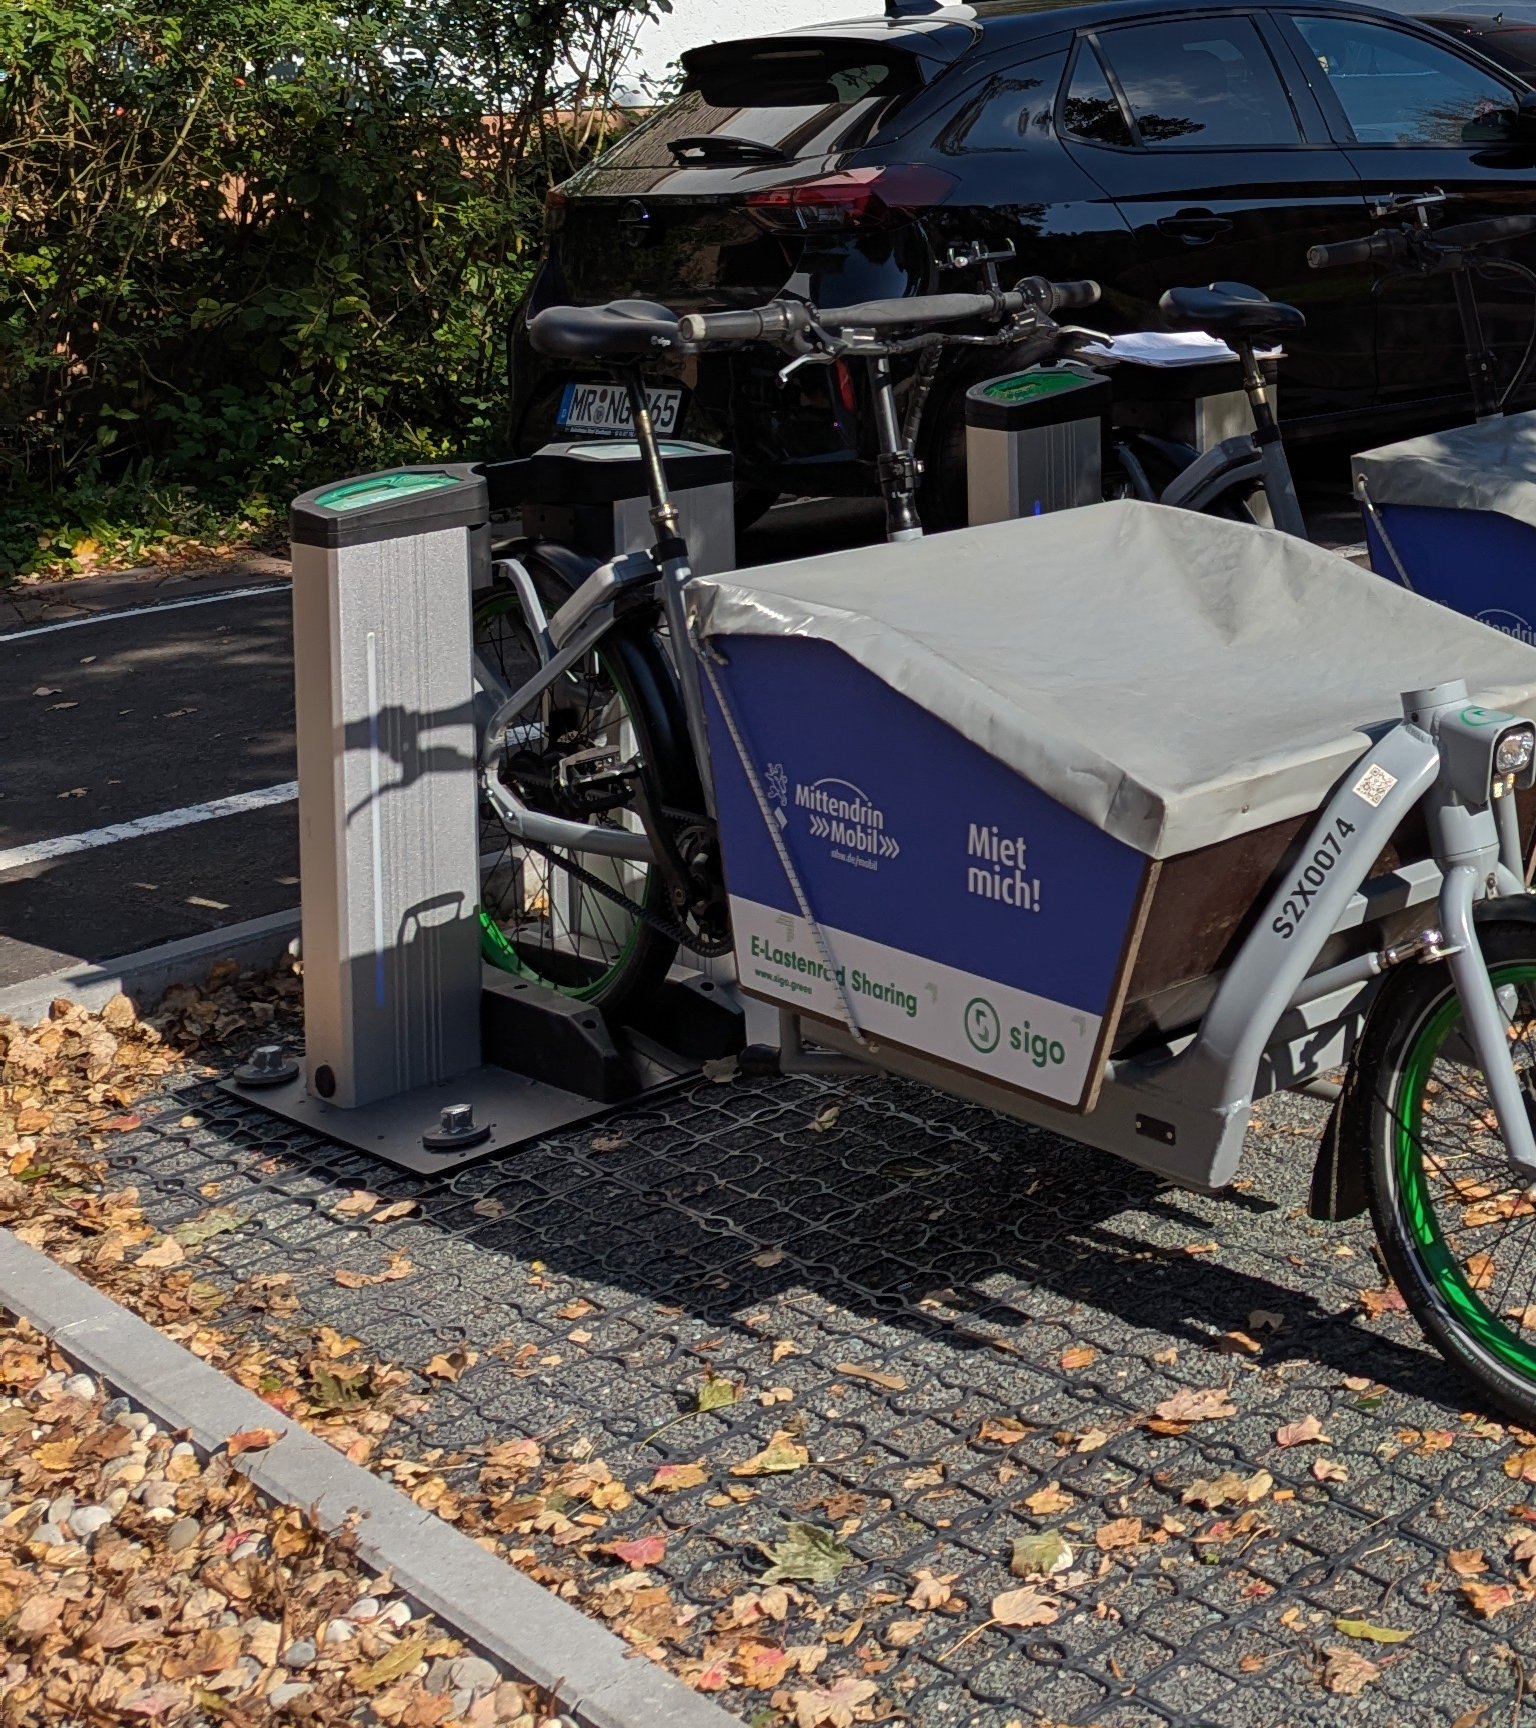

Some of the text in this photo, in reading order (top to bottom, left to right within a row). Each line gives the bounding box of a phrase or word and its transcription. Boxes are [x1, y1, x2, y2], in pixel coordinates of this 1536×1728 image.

[568, 388, 598, 422] MR
[604, 390, 632, 425] NG
[794, 783, 884, 830] Mittendrin
[830, 820, 878, 855] Mobil
[967, 822, 1027, 871] Miet
[967, 864, 1041, 913] mich!
[1272, 817, 1356, 939] S2X0074
[851, 969, 918, 1018] Sharing
[1009, 1019, 1066, 1068] sigo
